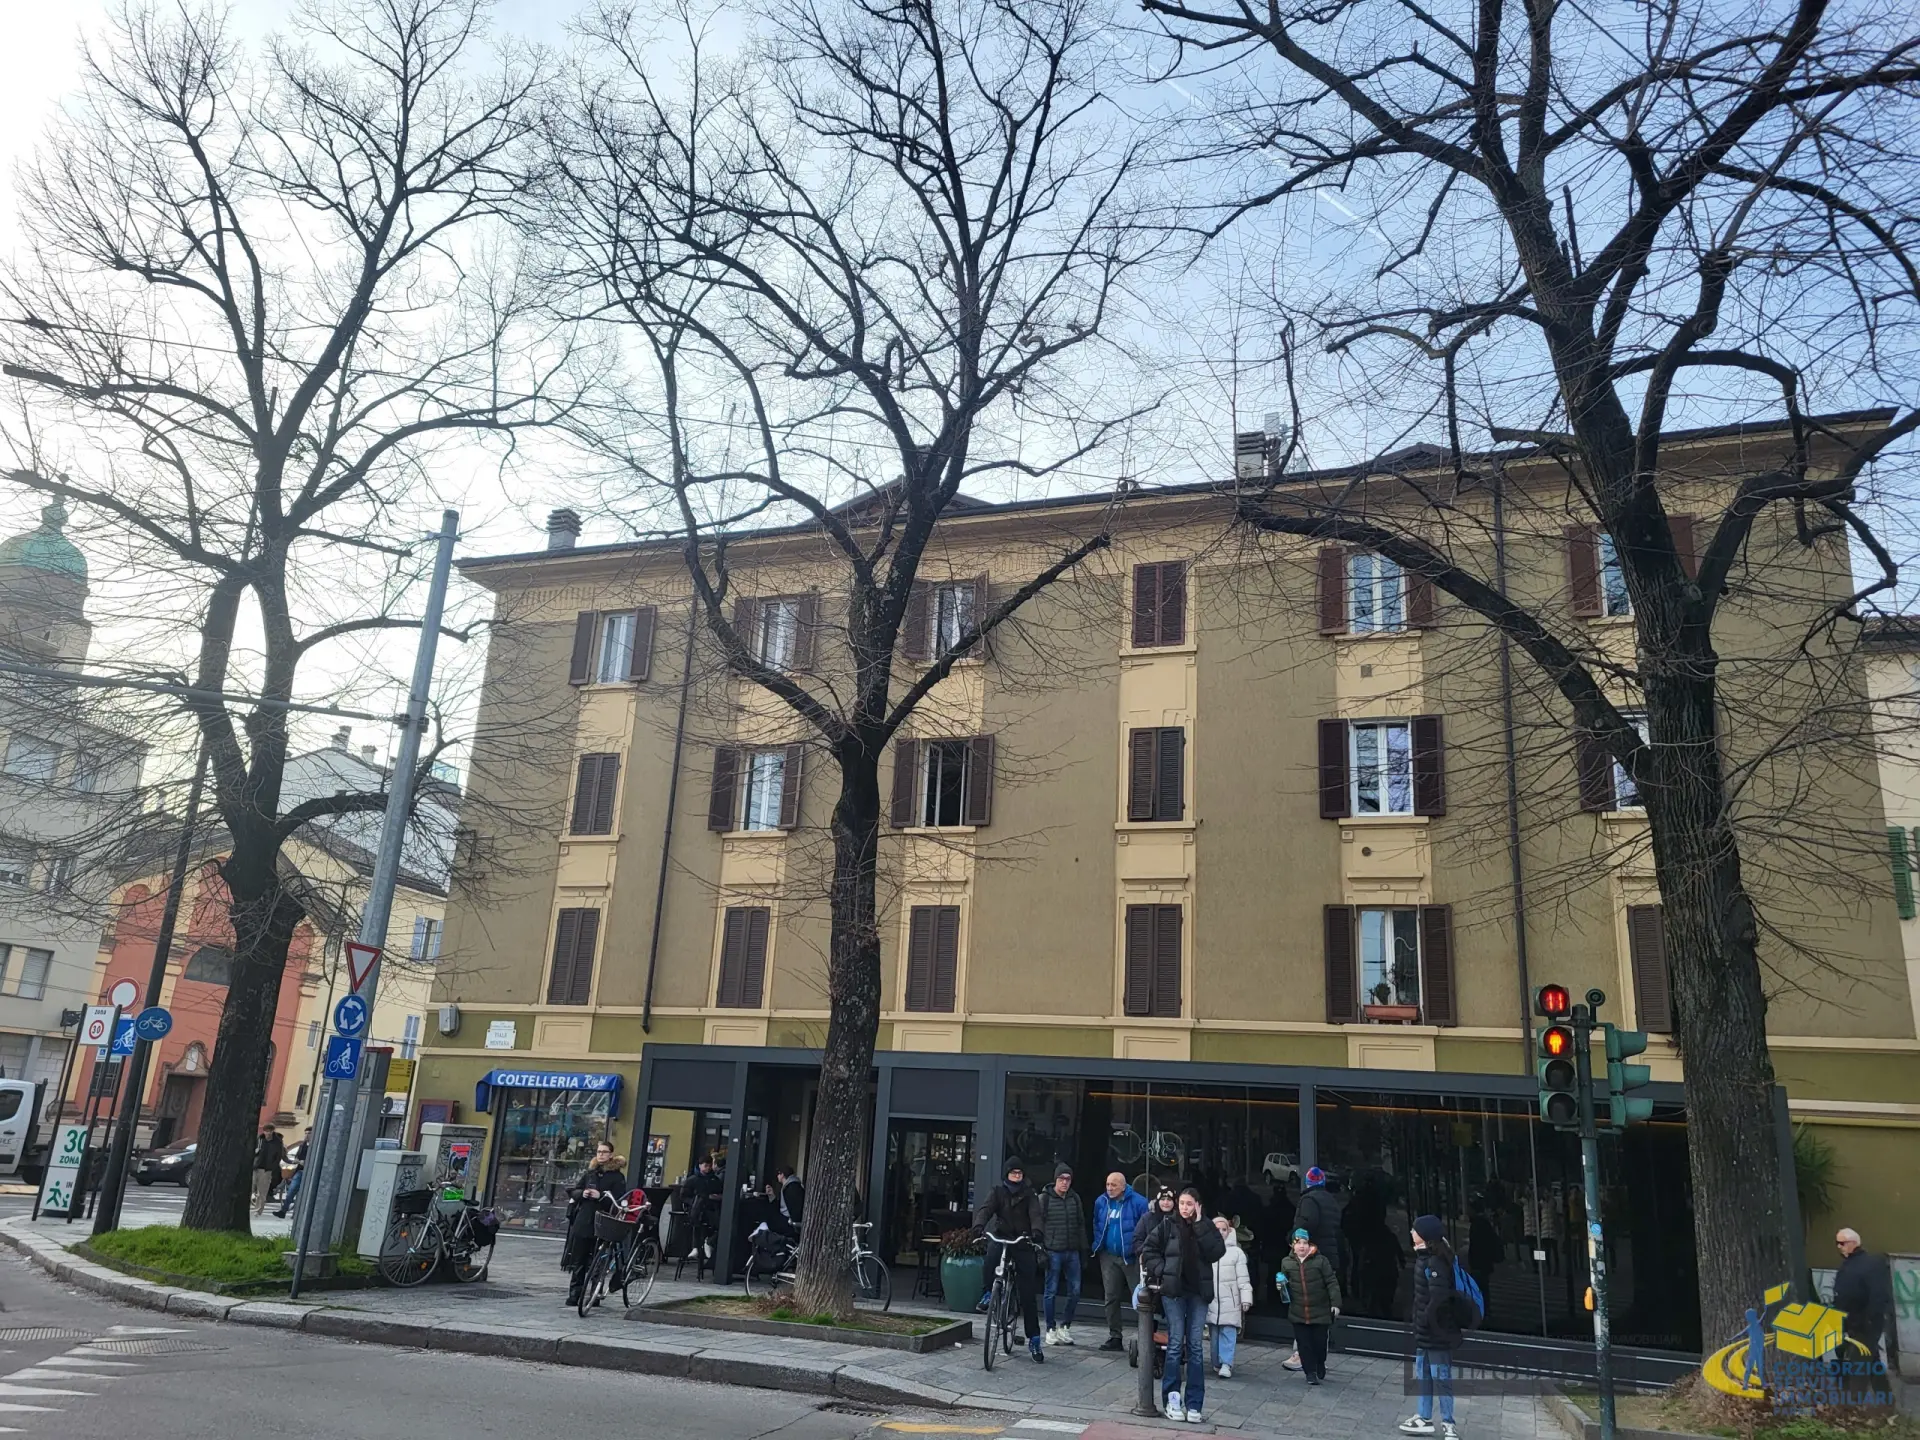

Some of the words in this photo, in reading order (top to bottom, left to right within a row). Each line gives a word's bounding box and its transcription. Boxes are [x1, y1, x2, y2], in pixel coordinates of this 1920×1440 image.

[91, 1025, 102, 1035] 30
[497, 1073, 579, 1088] COLTELLERIA
[59, 1155, 80, 1165] ZONA
